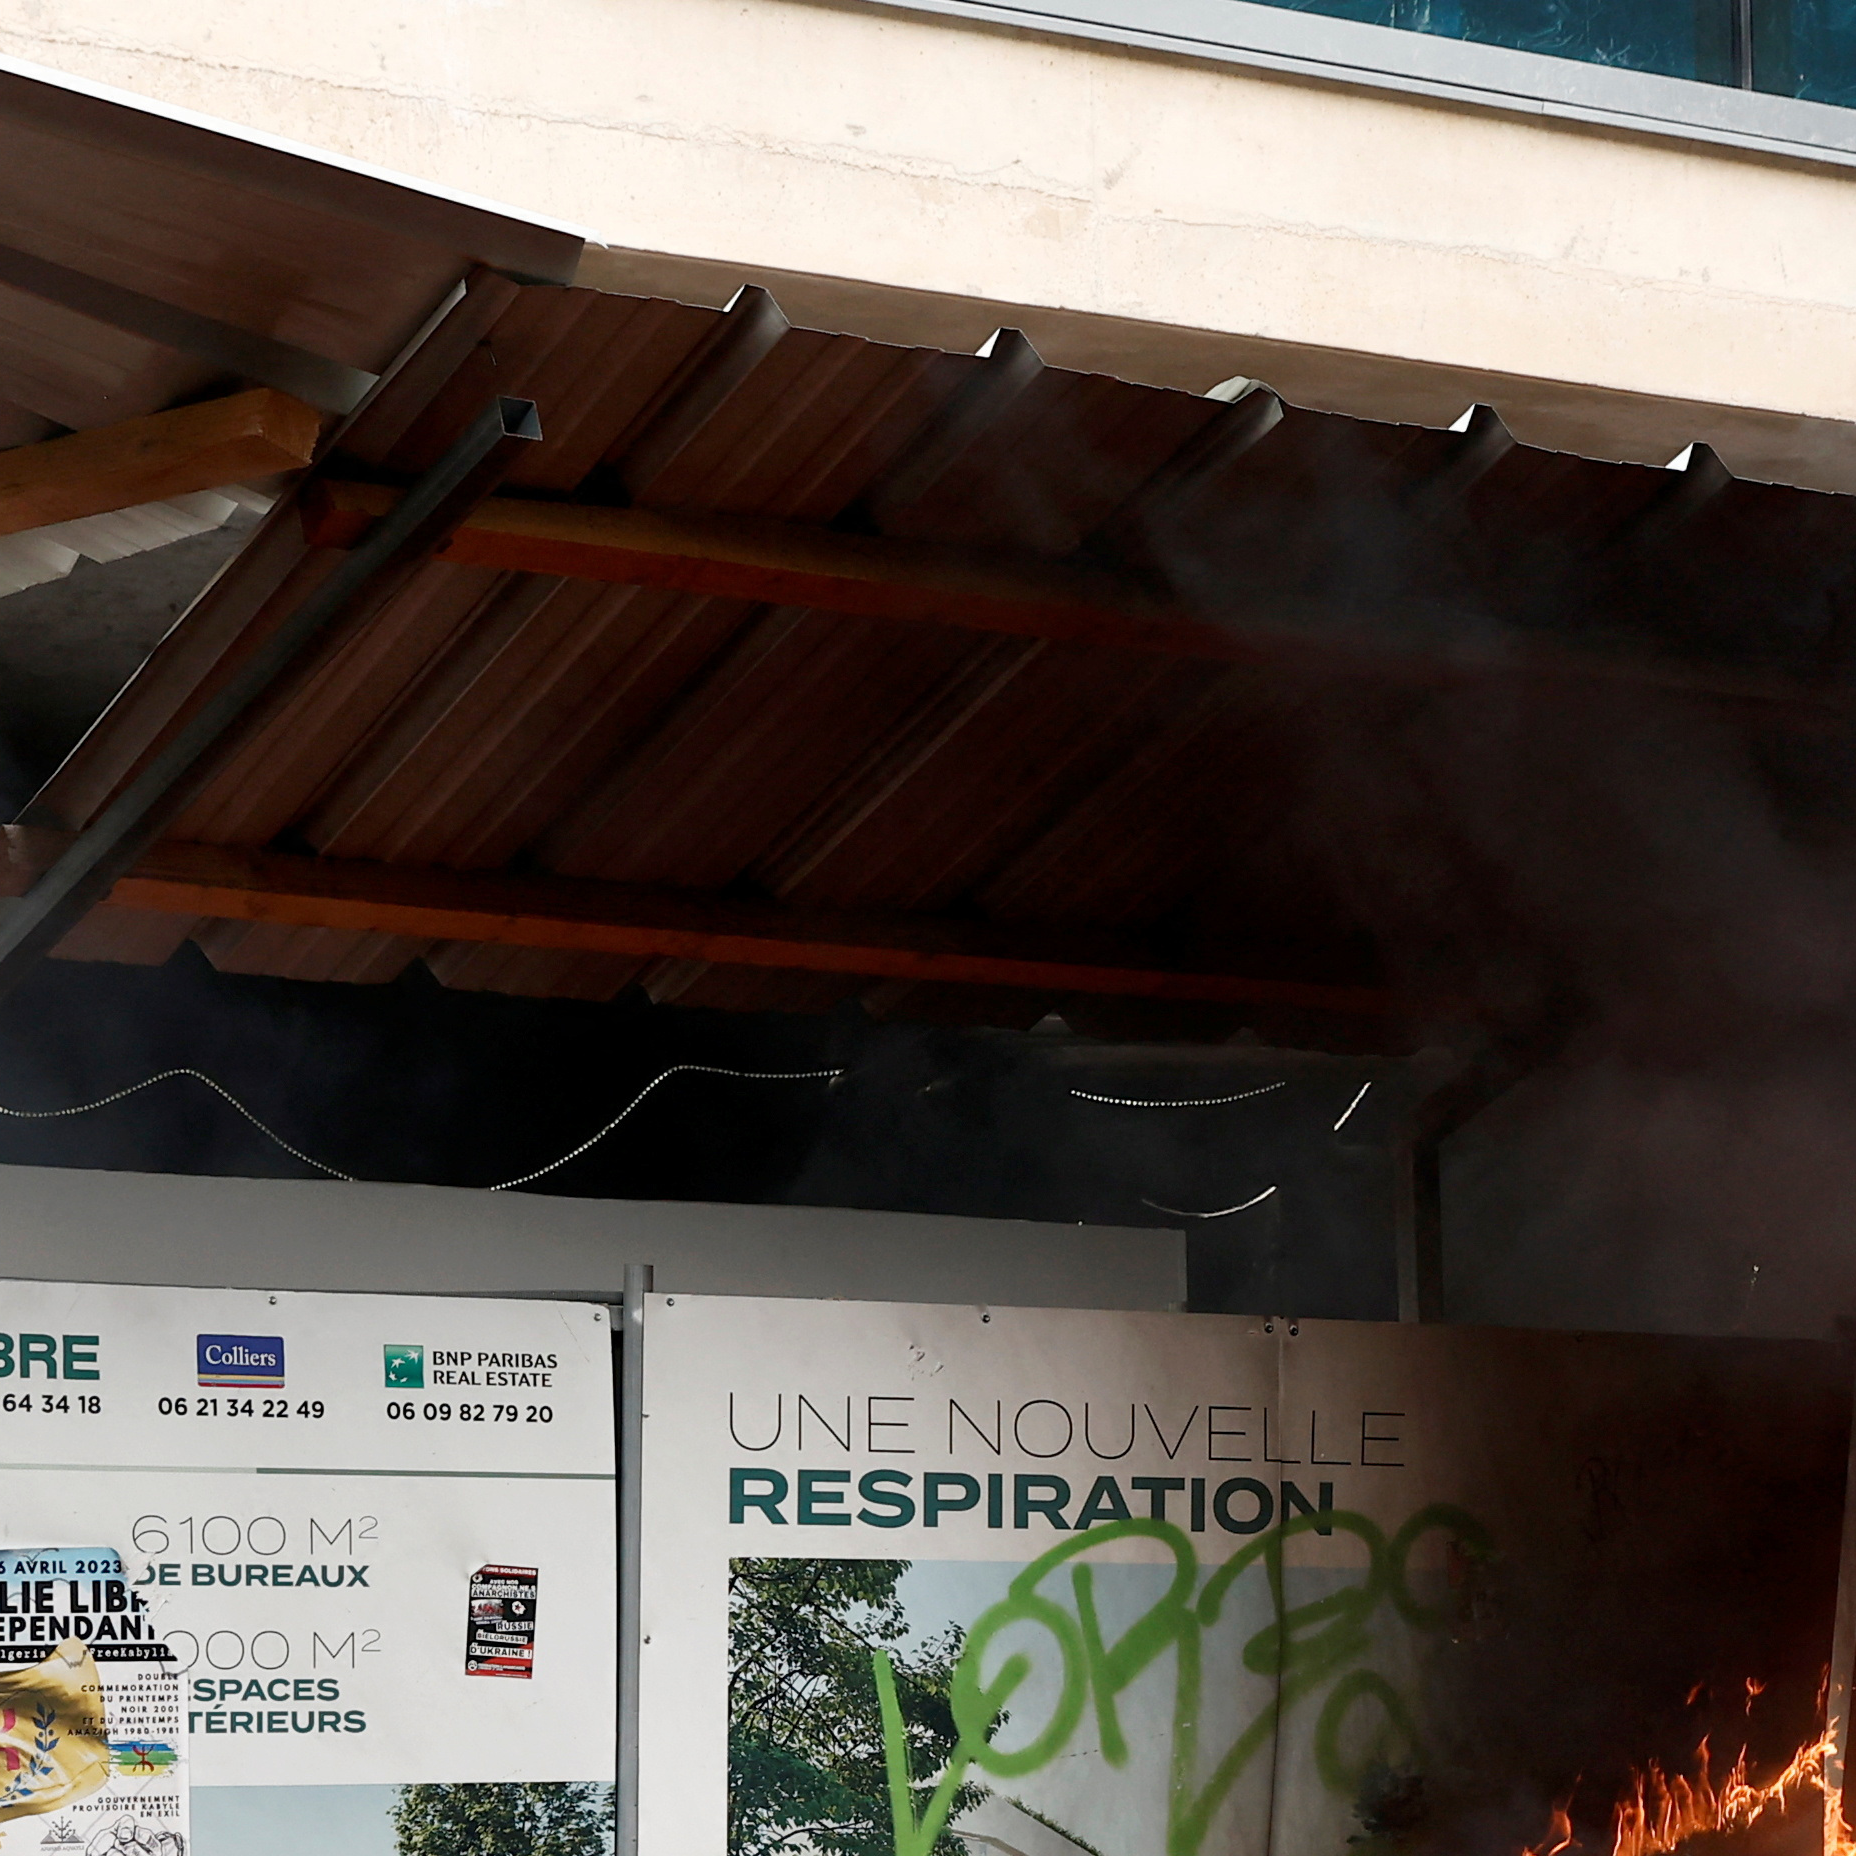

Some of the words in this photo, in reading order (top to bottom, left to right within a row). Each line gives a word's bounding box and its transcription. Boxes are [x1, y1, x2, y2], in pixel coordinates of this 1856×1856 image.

[205, 1344, 277, 1369] Colliers
[432, 1351, 474, 1368] BNP
[478, 1352, 558, 1370] PARIBAS
[432, 1369, 481, 1386] REAL
[486, 1371, 553, 1388] ESTATE
[2, 1393, 33, 1414] 64
[41, 1394, 70, 1415] 34
[77, 1395, 101, 1415] 18
[158, 1397, 188, 1417] 06
[196, 1398, 219, 1417] 21
[226, 1398, 255, 1418] 34
[262, 1399, 289, 1419] 22
[296, 1399, 325, 1419] 49
[387, 1402, 416, 1421] 06
[423, 1402, 452, 1422] 09
[459, 1403, 486, 1422] 82
[492, 1404, 518, 1423] 79
[526, 1405, 554, 1424] 20
[728, 1391, 916, 1454] UNE
[947, 1397, 1406, 1468] NOUVELLE
[728, 1467, 1334, 1536] RESPIRATION
[132, 1515, 286, 1555] 6100
[14, 1559, 67, 1575] AVRIL
[75, 1559, 122, 1574] 2023
[132, 1563, 181, 1586] DE
[191, 1564, 370, 1587] BUREAUX
[472, 1589, 536, 1598] ANARCHISTES
[497, 1622, 533, 1631] RUSSIE
[162, 1630, 290, 1672] 000
[470, 1646, 524, 1658] D'UKRAINE
[138, 1673, 179, 1681] DOUBLE
[80, 1684, 179, 1693] COMMEMORATION
[188, 1679, 339, 1701] SPACES
[99, 1695, 114, 1703] DU
[119, 1694, 179, 1703] PRINTEMPS
[154, 1705, 179, 1713] 2001
[99, 1716, 114, 1725] DU
[119, 1716, 179, 1725] PRINTEMPS
[67, 1728, 119, 1736] AMAZIGH
[124, 1726, 179, 1736] 1980-1981
[72, 1803, 136, 1812] PROVISOIRE
[97, 1795, 180, 1804] GOUVERNEMENT
